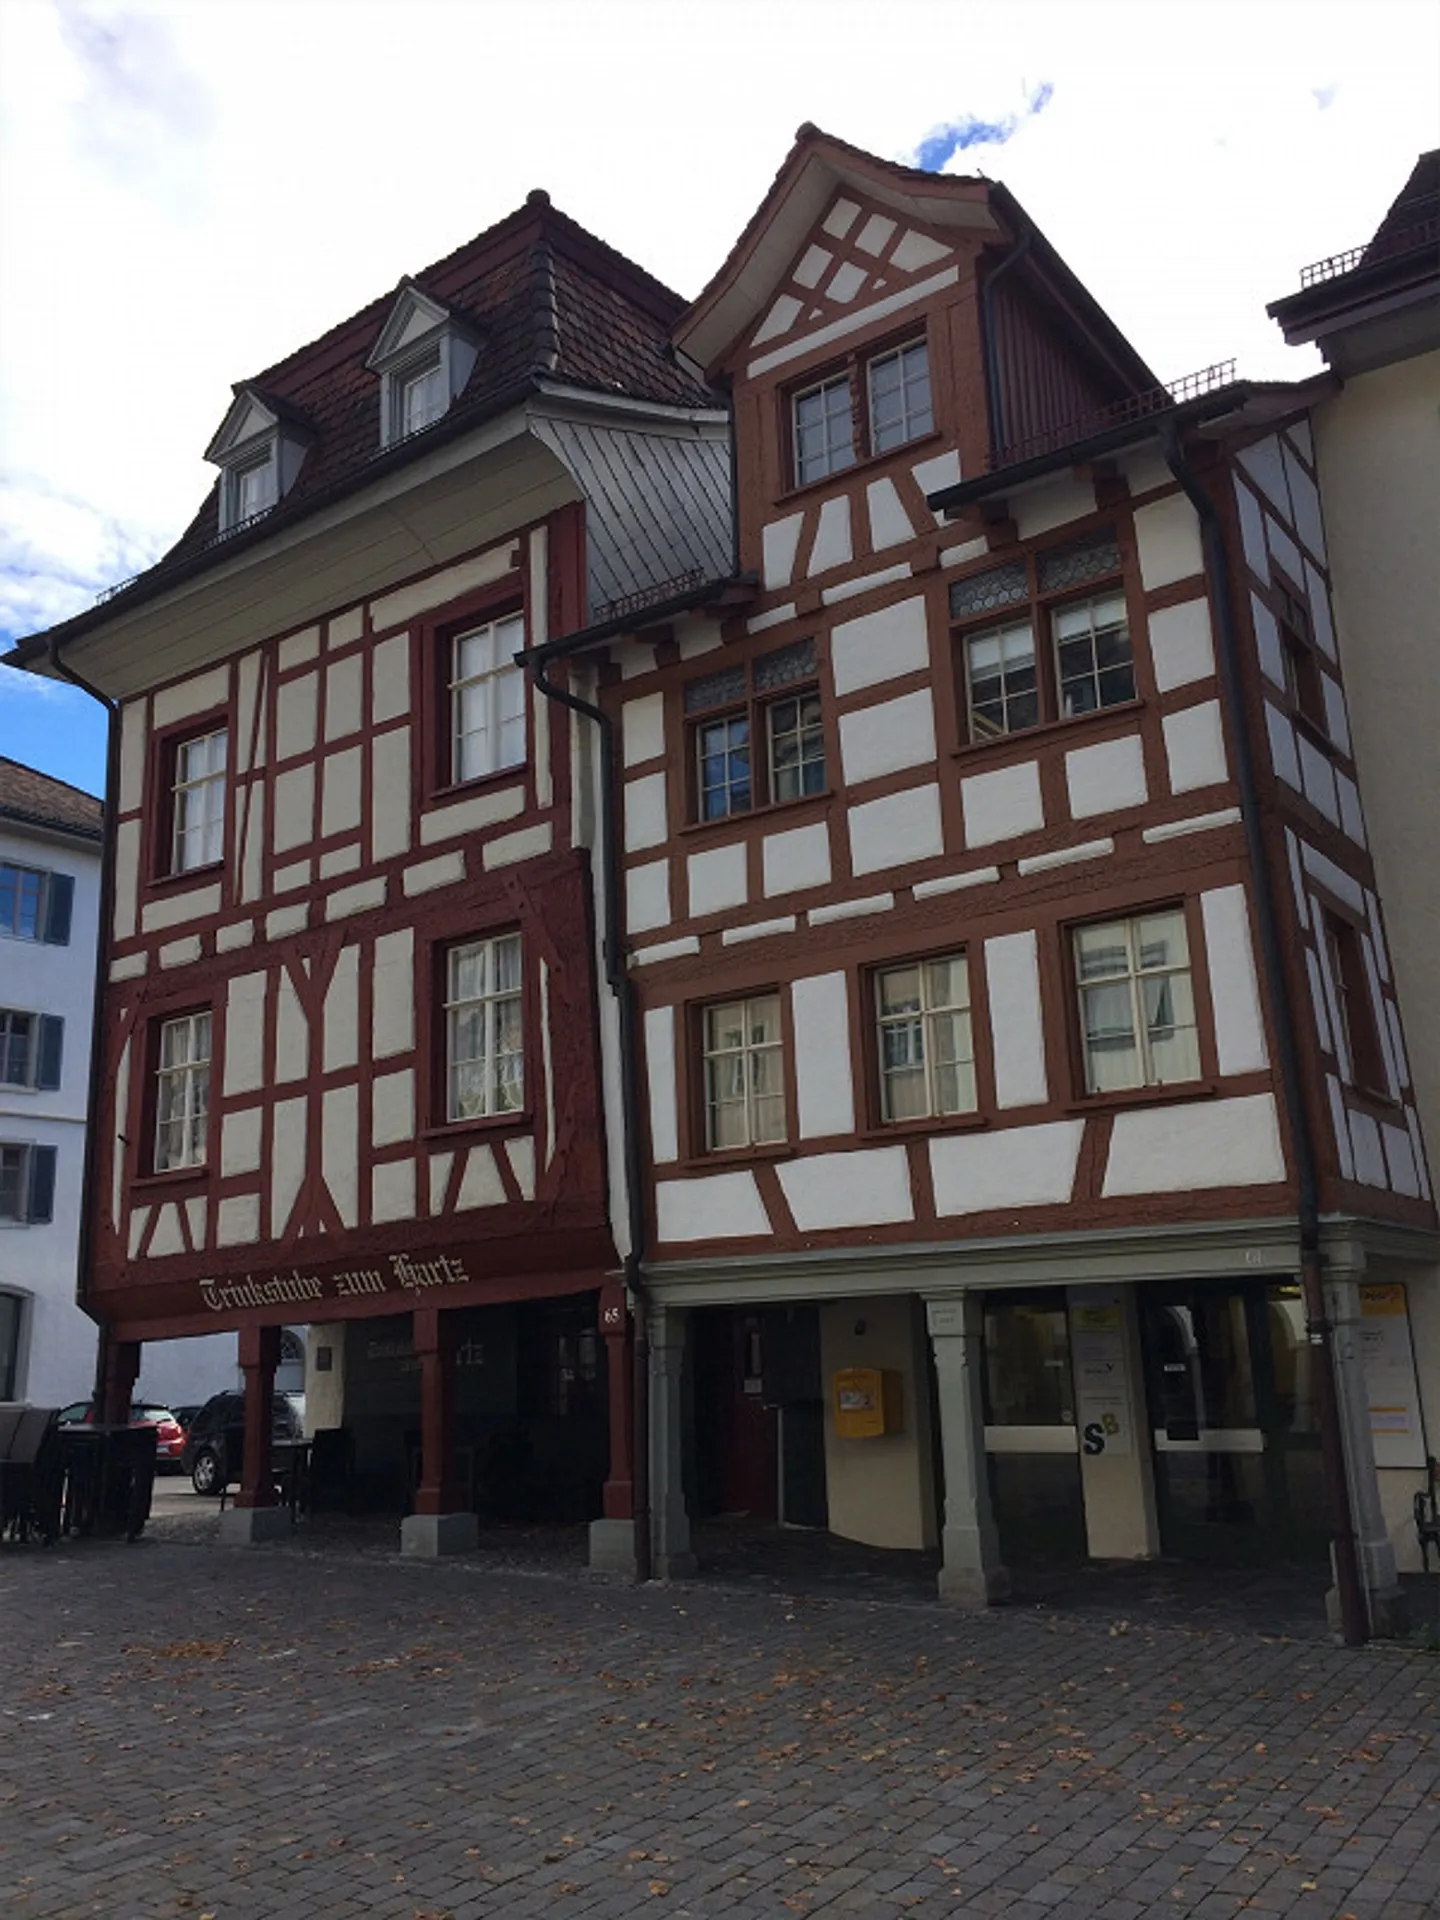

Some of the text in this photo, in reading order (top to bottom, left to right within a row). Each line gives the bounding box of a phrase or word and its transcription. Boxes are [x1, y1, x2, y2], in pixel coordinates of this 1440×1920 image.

[199, 1270, 323, 1311] Trinkstube
[332, 1269, 388, 1296] zum
[604, 1307, 621, 1324] 65
